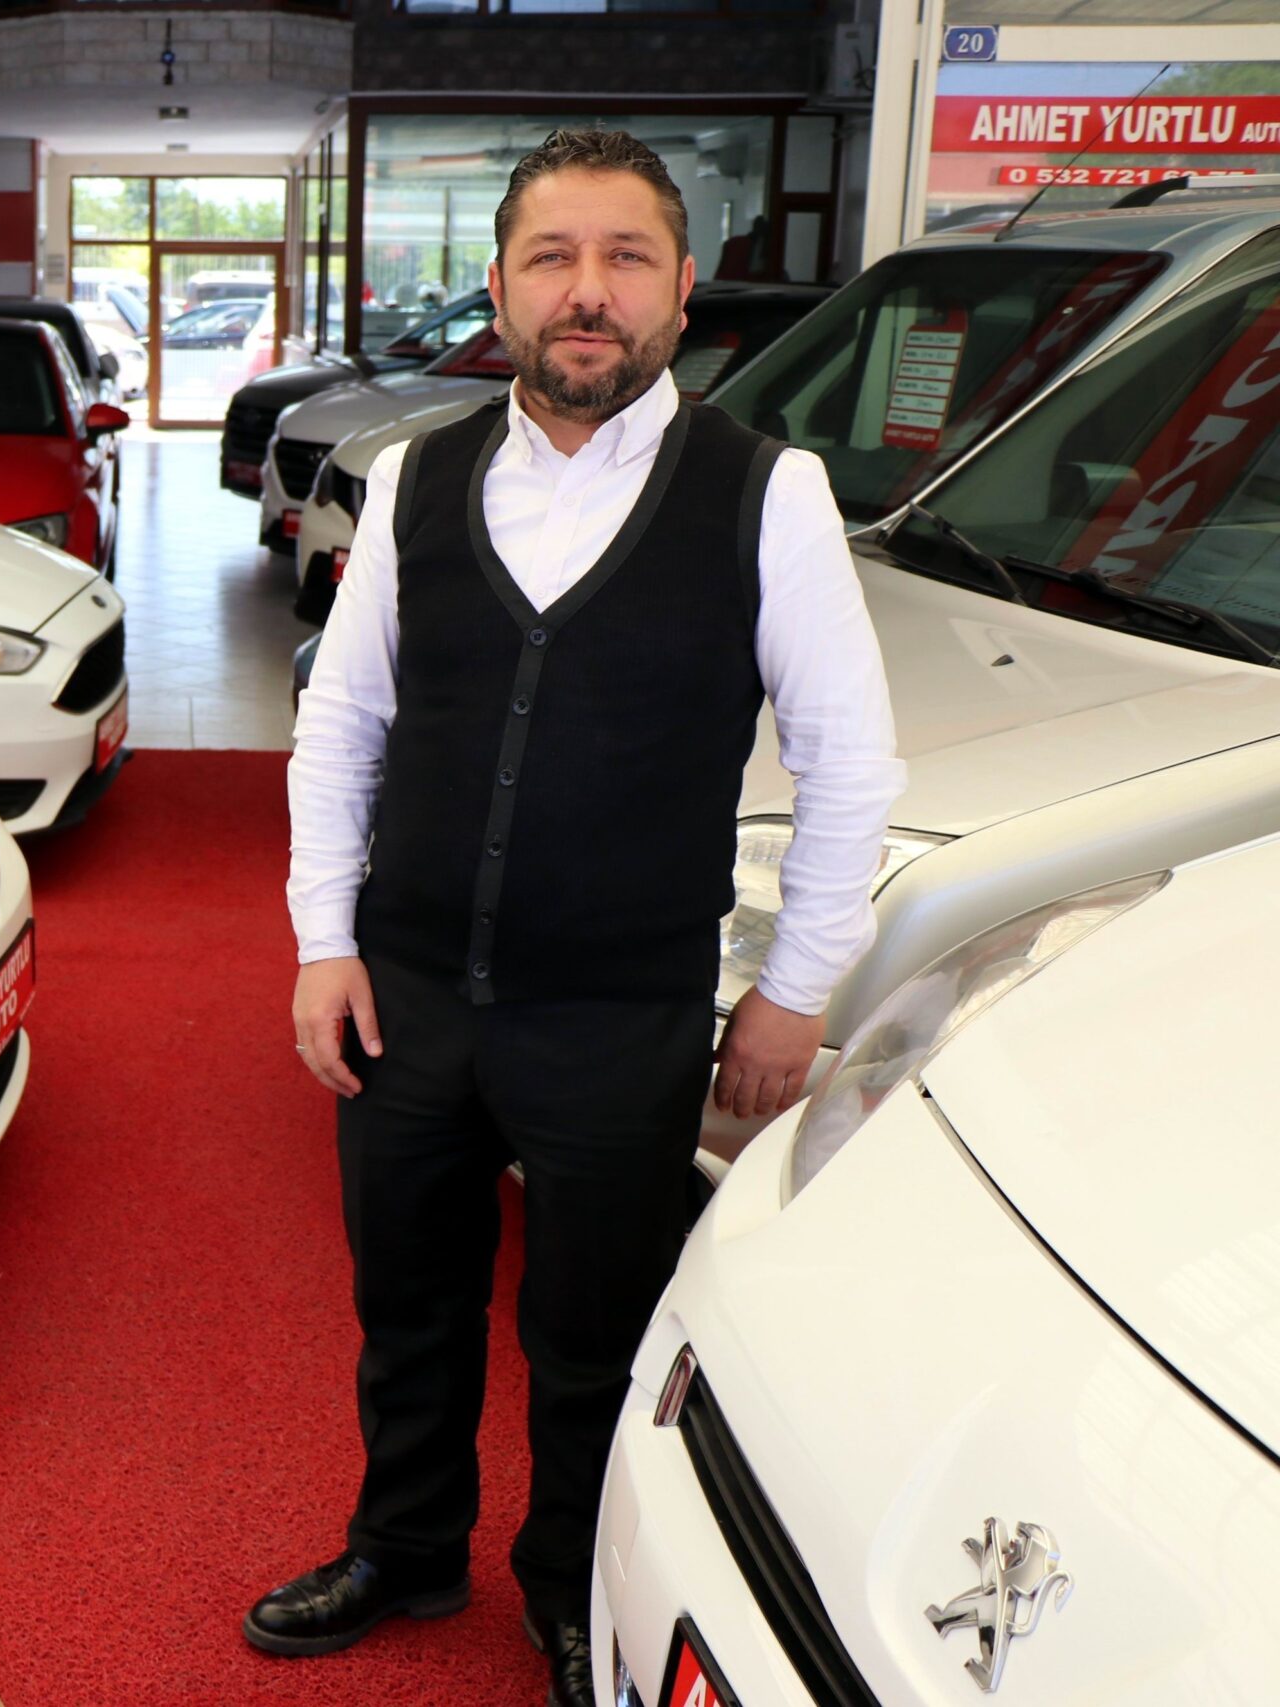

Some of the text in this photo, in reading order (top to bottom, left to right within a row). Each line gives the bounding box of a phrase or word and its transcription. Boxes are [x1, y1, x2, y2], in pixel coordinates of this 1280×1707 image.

[957, 33, 984, 53] 20
[970, 105, 1280, 143] AHMET YURTLU AUT
[1008, 168, 1028, 184] 0
[1035, 168, 1090, 184] 532
[1098, 169, 1151, 185] 721
